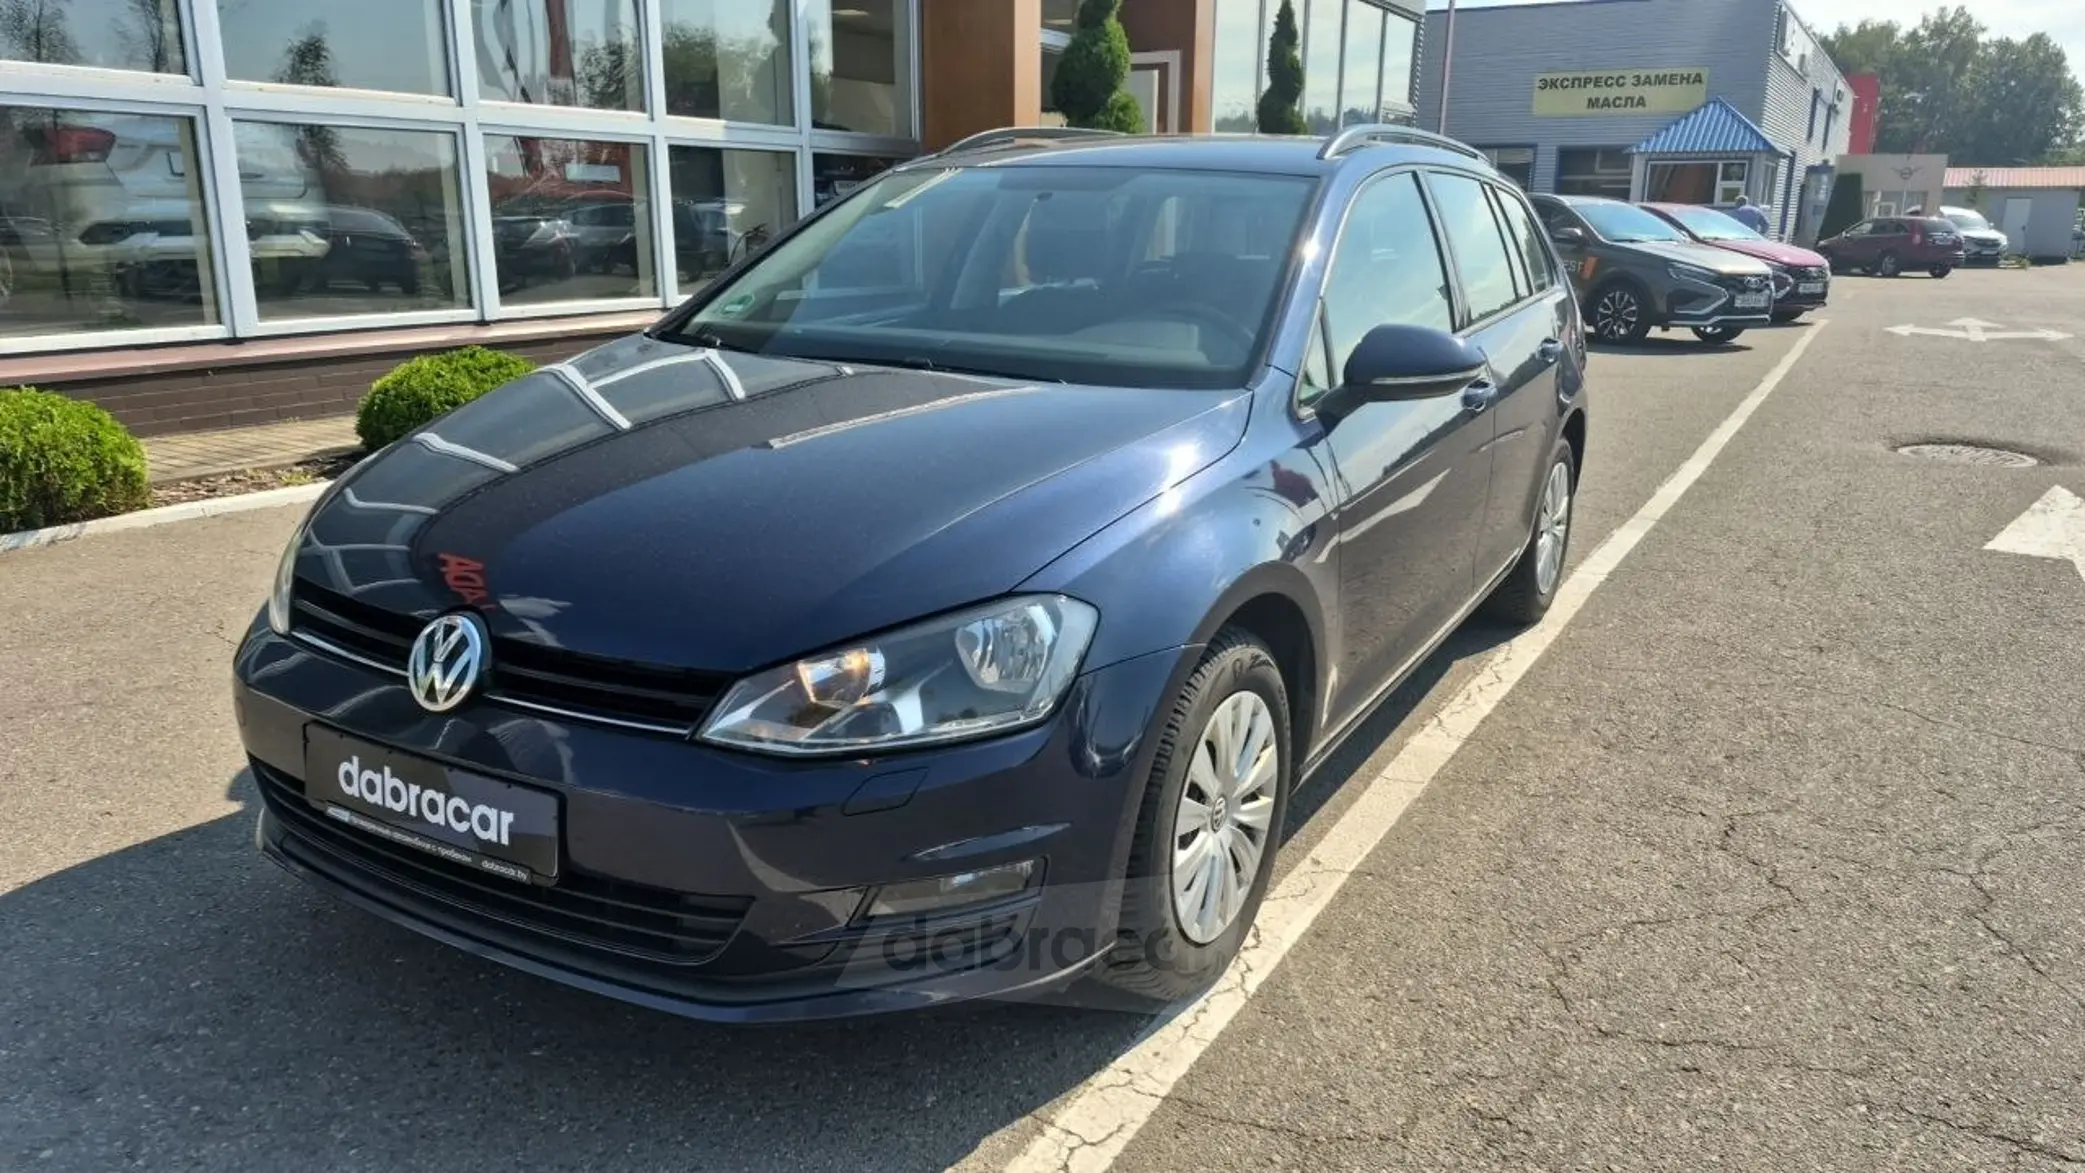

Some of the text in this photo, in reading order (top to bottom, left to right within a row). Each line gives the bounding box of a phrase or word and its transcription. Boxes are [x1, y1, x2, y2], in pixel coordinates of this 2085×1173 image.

[1538, 72, 1703, 90] ЭКСПРЕСС ЗАМЕНА
[1586, 95, 1647, 109] МАСЛА
[338, 755, 514, 846] dabracar
